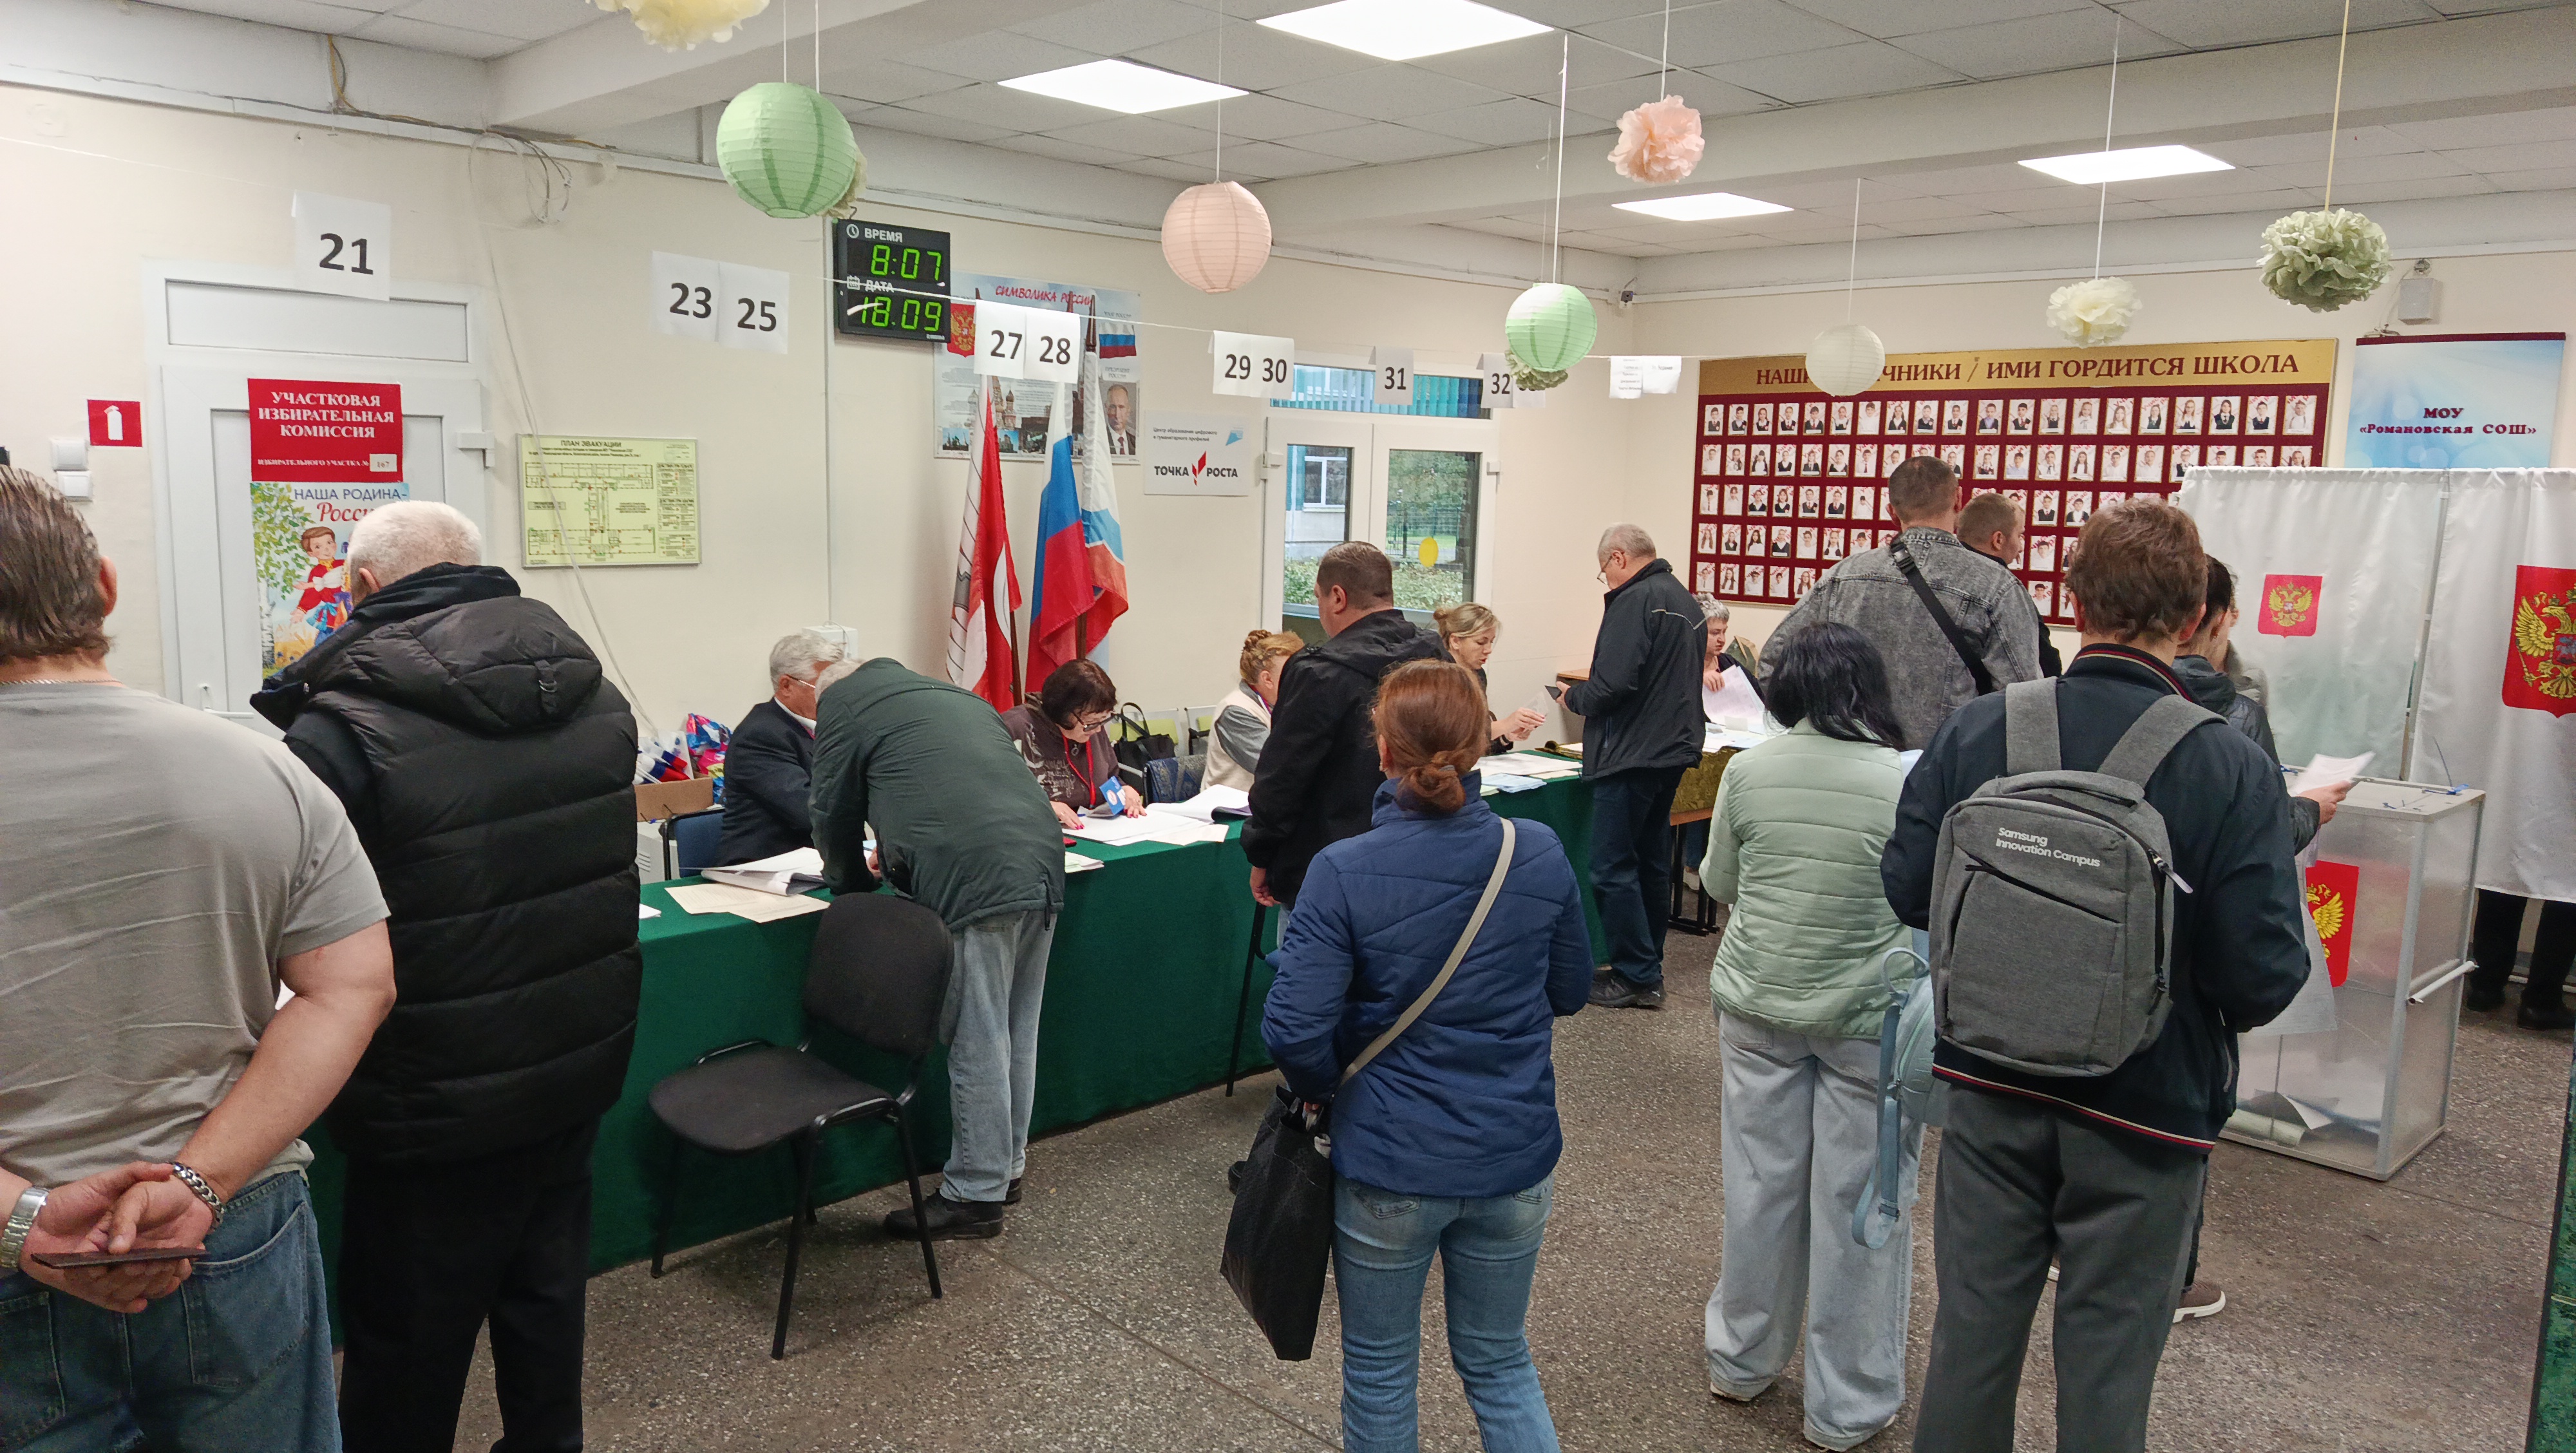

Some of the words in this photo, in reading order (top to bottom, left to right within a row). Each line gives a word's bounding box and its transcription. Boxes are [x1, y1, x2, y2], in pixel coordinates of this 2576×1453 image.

[864, 227, 903, 243] ВРЕМЯ
[319, 233, 374, 276] 21
[871, 244, 942, 281] 8:07
[865, 280, 895, 292] ДАТА
[995, 285, 1057, 302] СИМВОЛИКА
[670, 282, 712, 319] 23
[737, 298, 777, 332] 25
[861, 296, 942, 332] 18.09
[990, 330, 1023, 359] 27
[1039, 336, 1070, 365] 28
[1225, 354, 1251, 380] 29
[1262, 357, 1287, 383] 30
[1986, 361, 2041, 379] ИМИ
[2049, 357, 2185, 378] ГОРДИТСЯ
[2193, 354, 2299, 375] ШКОЛА
[1385, 366, 1406, 390] 31
[1491, 373, 1510, 394] 32
[270, 391, 381, 407] УЧАСТКОВАЯ
[258, 408, 394, 423] ИЗБИРАТЕЛЬНАЯ
[2423, 408, 2464, 419] МОУ
[280, 424, 375, 438] КОМИССИЯ
[2360, 424, 2474, 434] «Романовская
[2483, 424, 2536, 435] СОШ»
[1154, 466, 1189, 477] ТОЧКА
[1206, 467, 1238, 477] РОСТА
[294, 488, 339, 500] НАША
[1998, 827, 2048, 847] Samsung
[1996, 838, 2051, 857] Innovation
[2053, 850, 2101, 868] Campus
